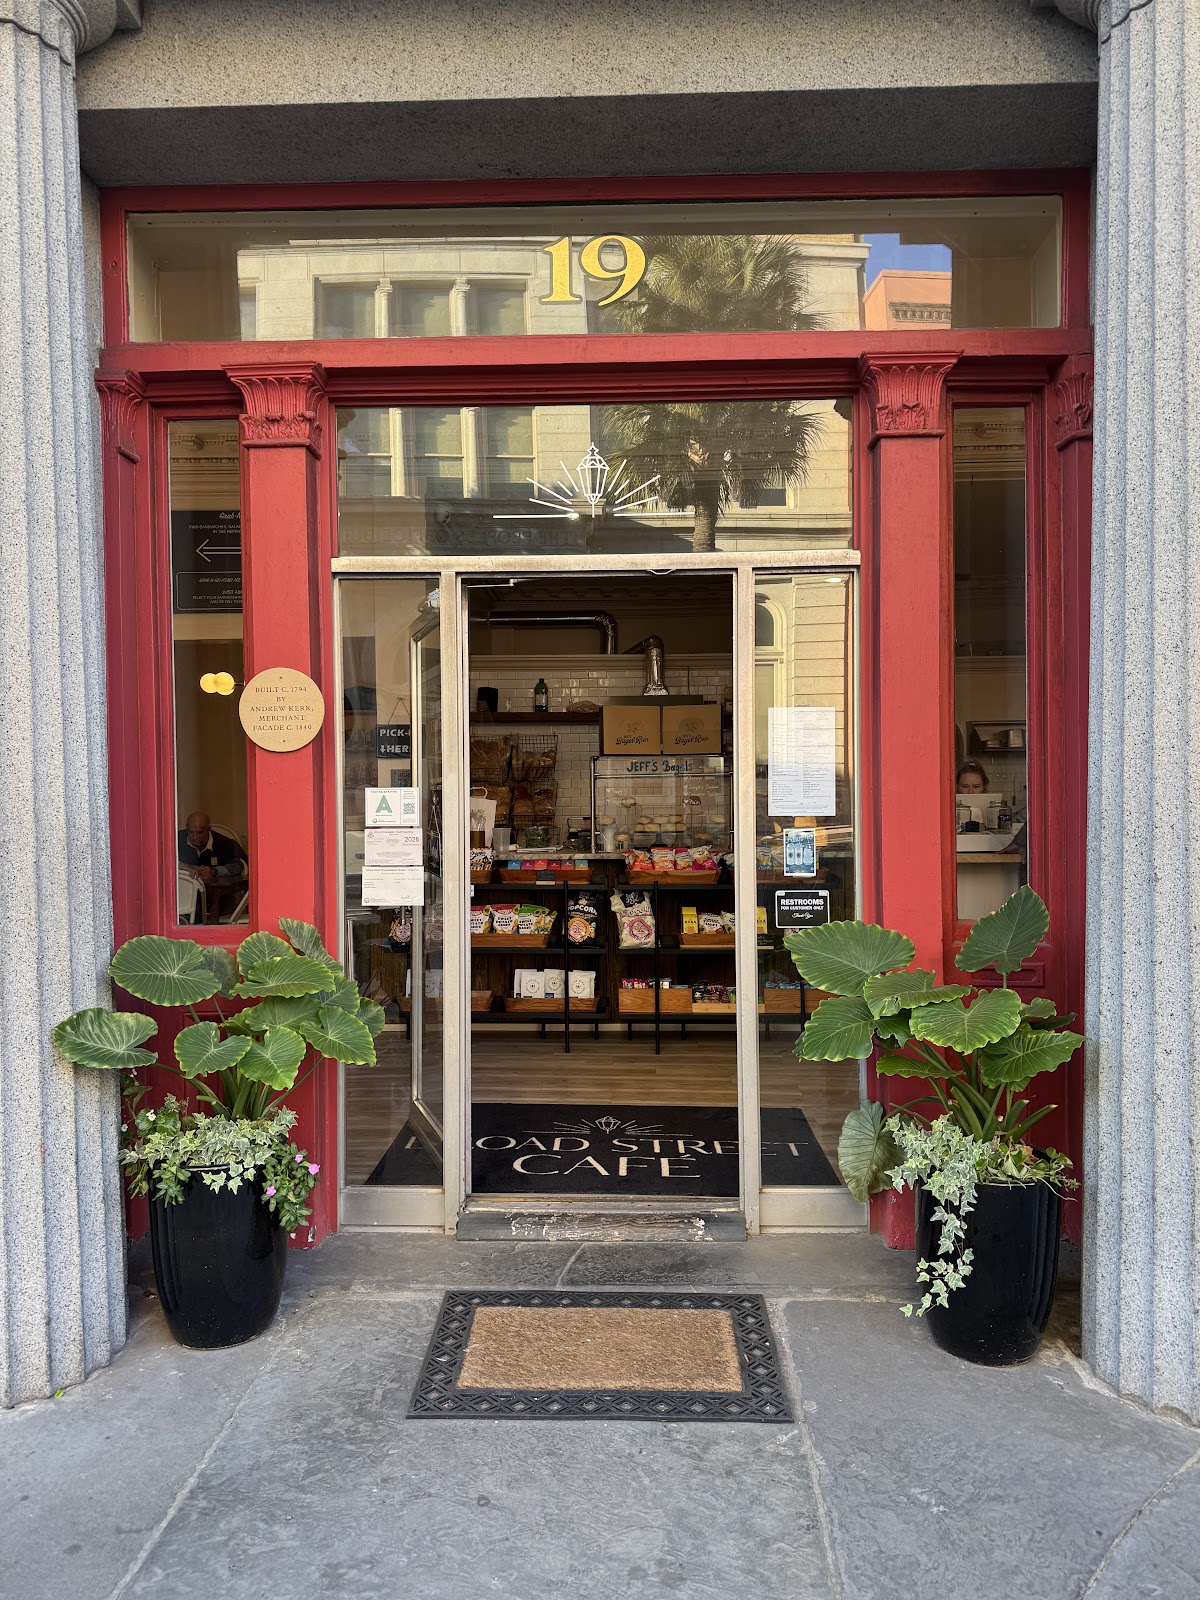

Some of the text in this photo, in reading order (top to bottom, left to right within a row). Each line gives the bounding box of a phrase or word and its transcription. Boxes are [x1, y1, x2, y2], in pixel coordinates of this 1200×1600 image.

[540, 233, 647, 308] 19
[380, 729, 410, 737] PICK-
[387, 745, 411, 753] HER
[627, 760, 693, 776] JEFF'S Bagels
[375, 794, 393, 813] A
[512, 1153, 701, 1178] CAFÉ
